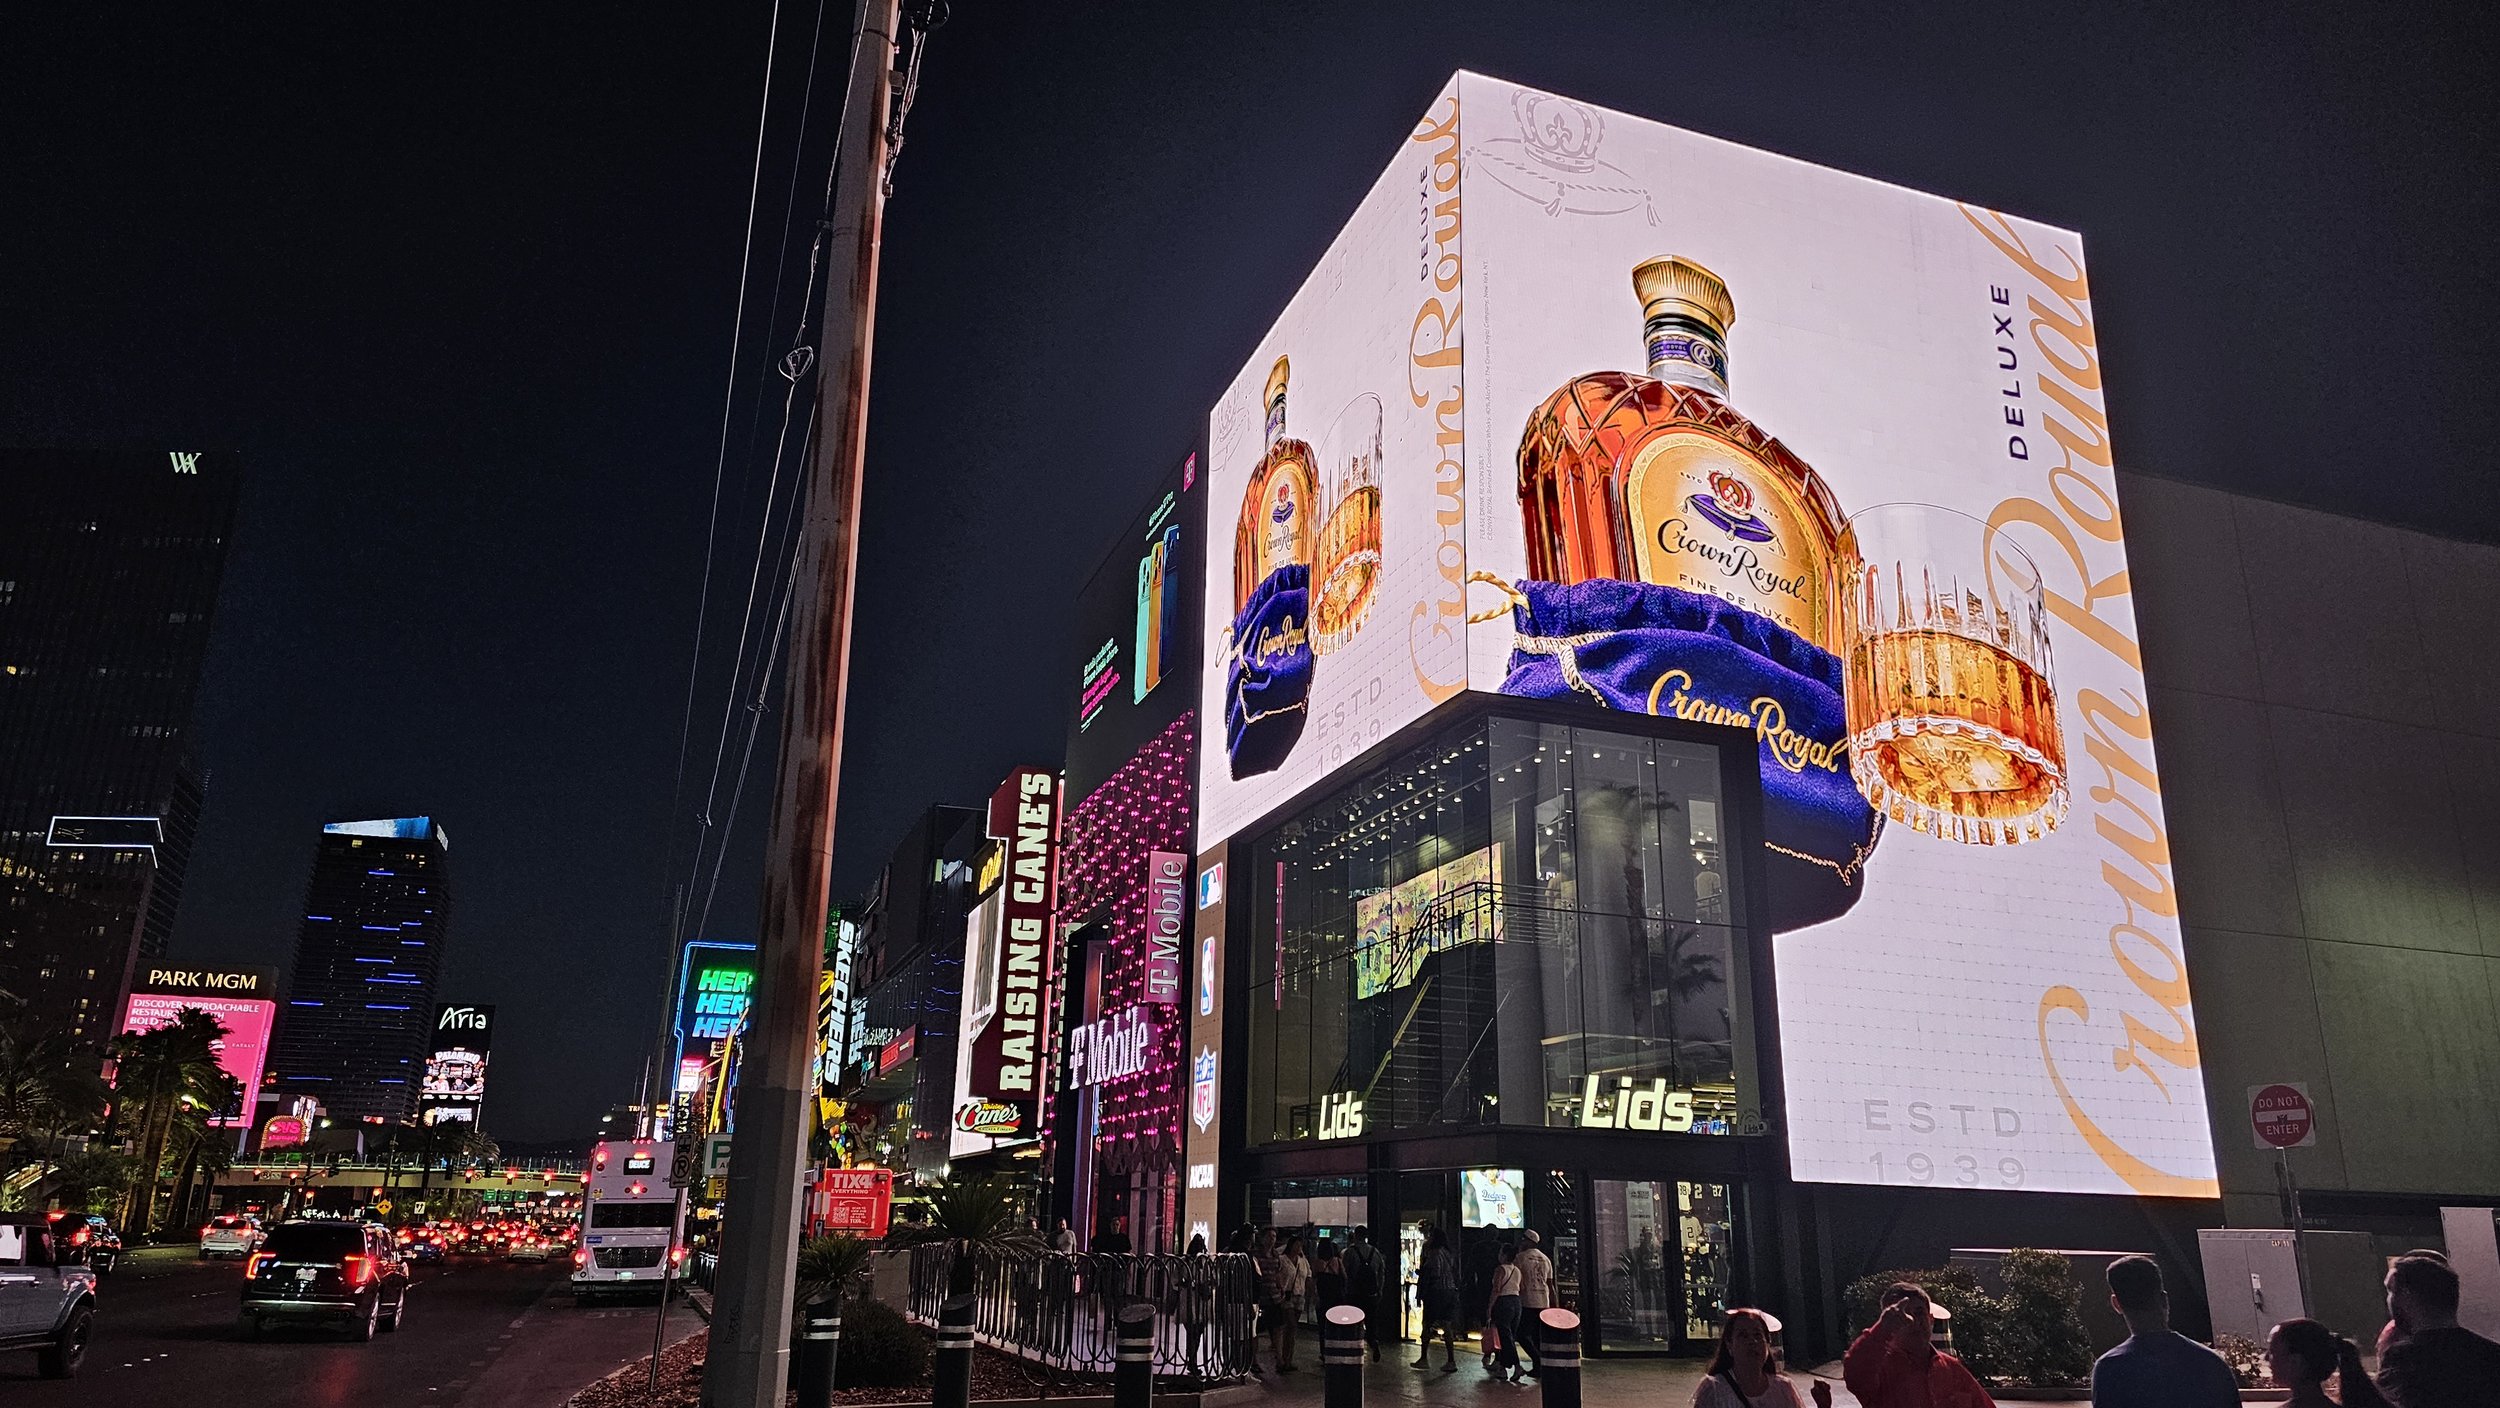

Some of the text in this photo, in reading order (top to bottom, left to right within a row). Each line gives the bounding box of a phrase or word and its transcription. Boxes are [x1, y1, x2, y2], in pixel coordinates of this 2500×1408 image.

[1420, 165, 1429, 282] DELUXE
[1990, 283, 2029, 461] DELUXE
[1263, 521, 1303, 559] Crown Royal
[1657, 518, 1806, 596] Crown Royal
[1679, 573, 1795, 626] FINE DE LUXE
[1256, 614, 1310, 668] Crown Royal
[1317, 676, 1383, 741] ESTD
[1647, 668, 1849, 774] Crown Royal
[1317, 718, 1382, 776] 1939
[1000, 773, 1051, 1092] RAISING CANE'S
[2037, 687, 2221, 1198] Crown
[148, 969, 257, 990] PARK MGM
[824, 919, 855, 1086] SKECHERS
[129, 1016, 160, 1026] BOLD
[133, 999, 260, 1013] DISCOVER APPROACHABLE
[439, 1007, 487, 1030] Aria
[959, 1100, 1022, 1131] Cane's
[1196, 1083, 1213, 1116] NFL
[1319, 1090, 1363, 1141] Lids
[1581, 1074, 1695, 1132] Lids
[1863, 1098, 2022, 1138] ESTD
[2258, 1096, 2300, 1109] DO NOT
[2266, 1124, 2300, 1135] ENTER
[1869, 1151, 2026, 1189] 1939
[1496, 1203, 1505, 1214] 16
